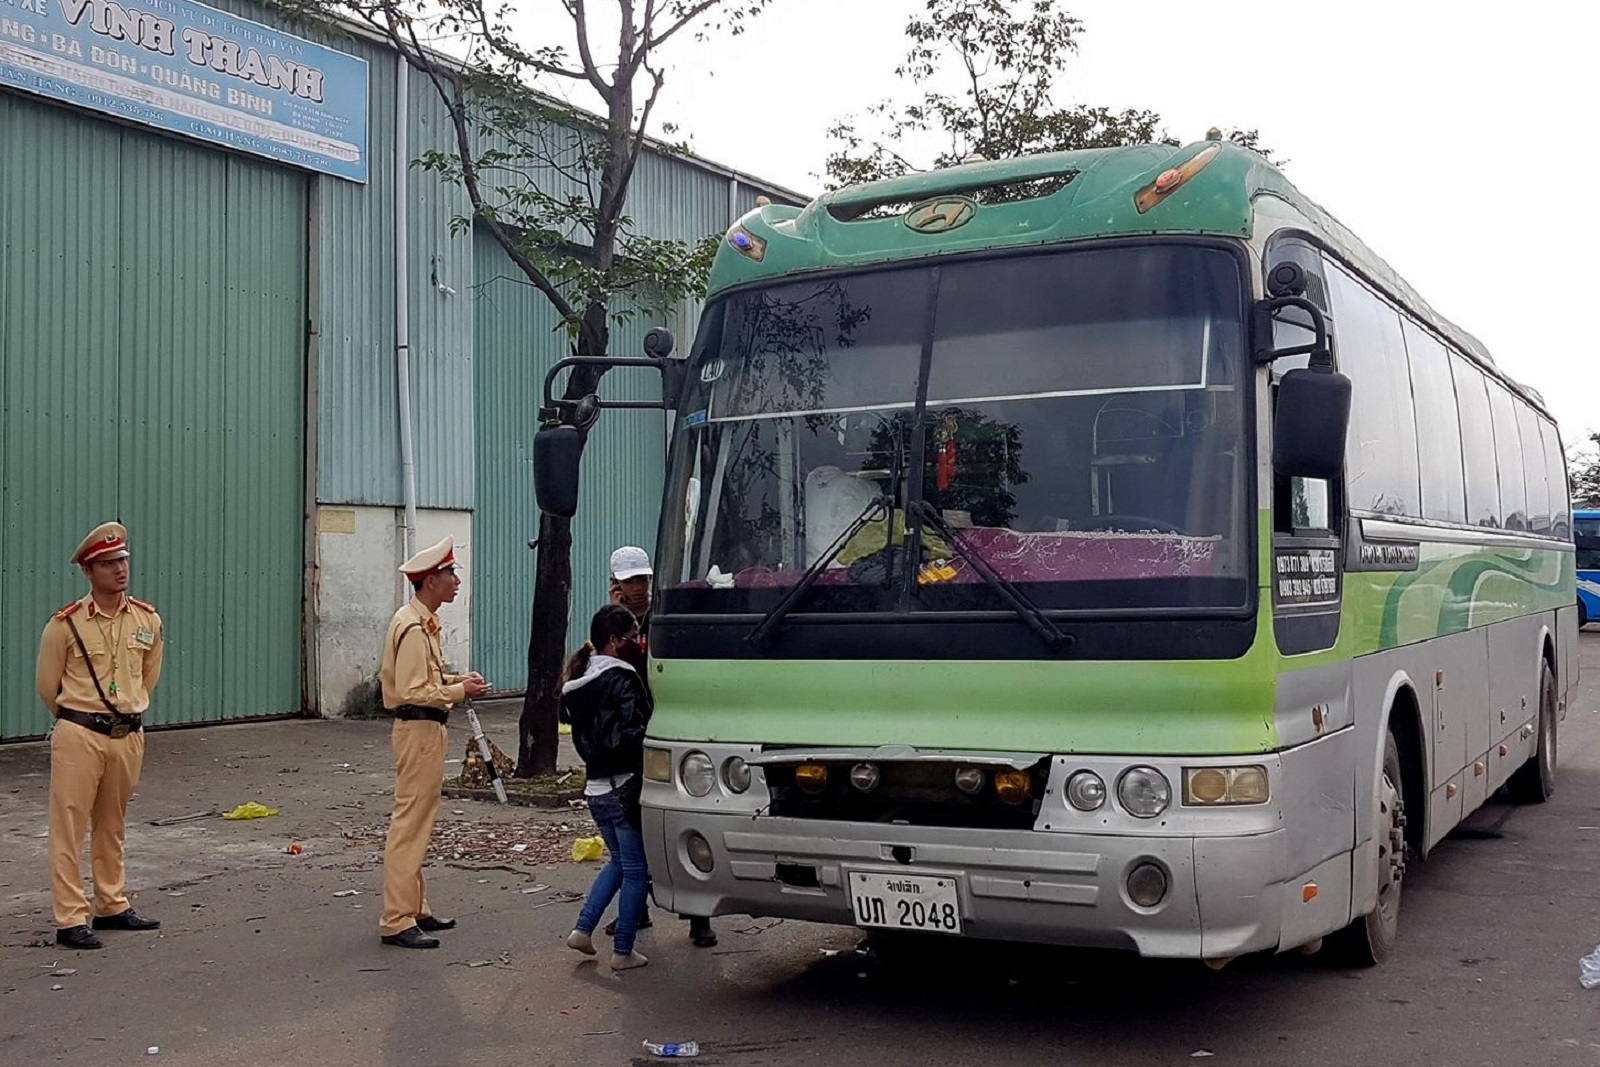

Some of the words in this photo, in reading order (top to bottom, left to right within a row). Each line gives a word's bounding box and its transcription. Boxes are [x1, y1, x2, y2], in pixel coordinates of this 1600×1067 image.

[52, 33, 82, 57] BA
[150, 64, 220, 99] QUẢNG
[181, 26, 326, 105] THANH
[897, 898, 957, 930] 2048
